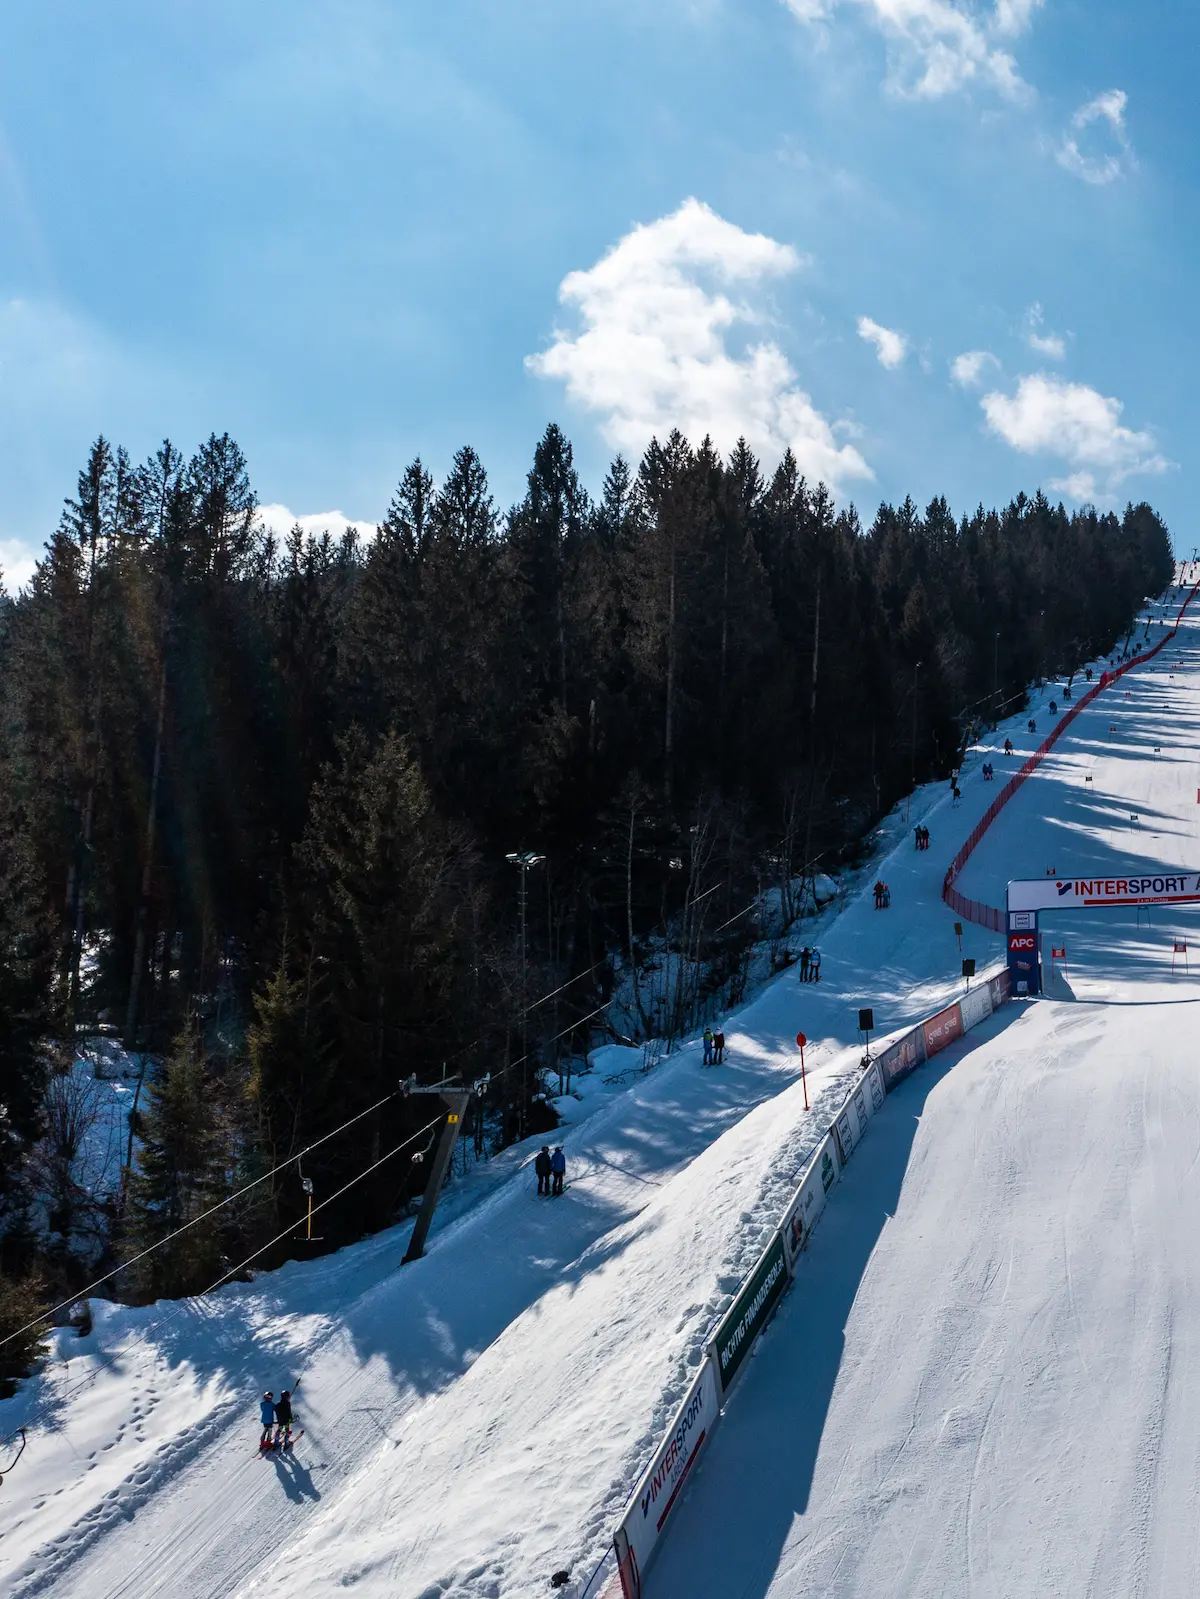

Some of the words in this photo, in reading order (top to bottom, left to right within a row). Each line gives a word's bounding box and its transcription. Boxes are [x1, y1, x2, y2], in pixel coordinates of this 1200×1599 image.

[1075, 877, 1187, 895] INTERSPORT
[1011, 938, 1034, 948] APC
[721, 1319, 745, 1369] RICHTIG
[650, 1387, 704, 1503] INTERSPORT
[670, 1447, 689, 1489] ARENA
